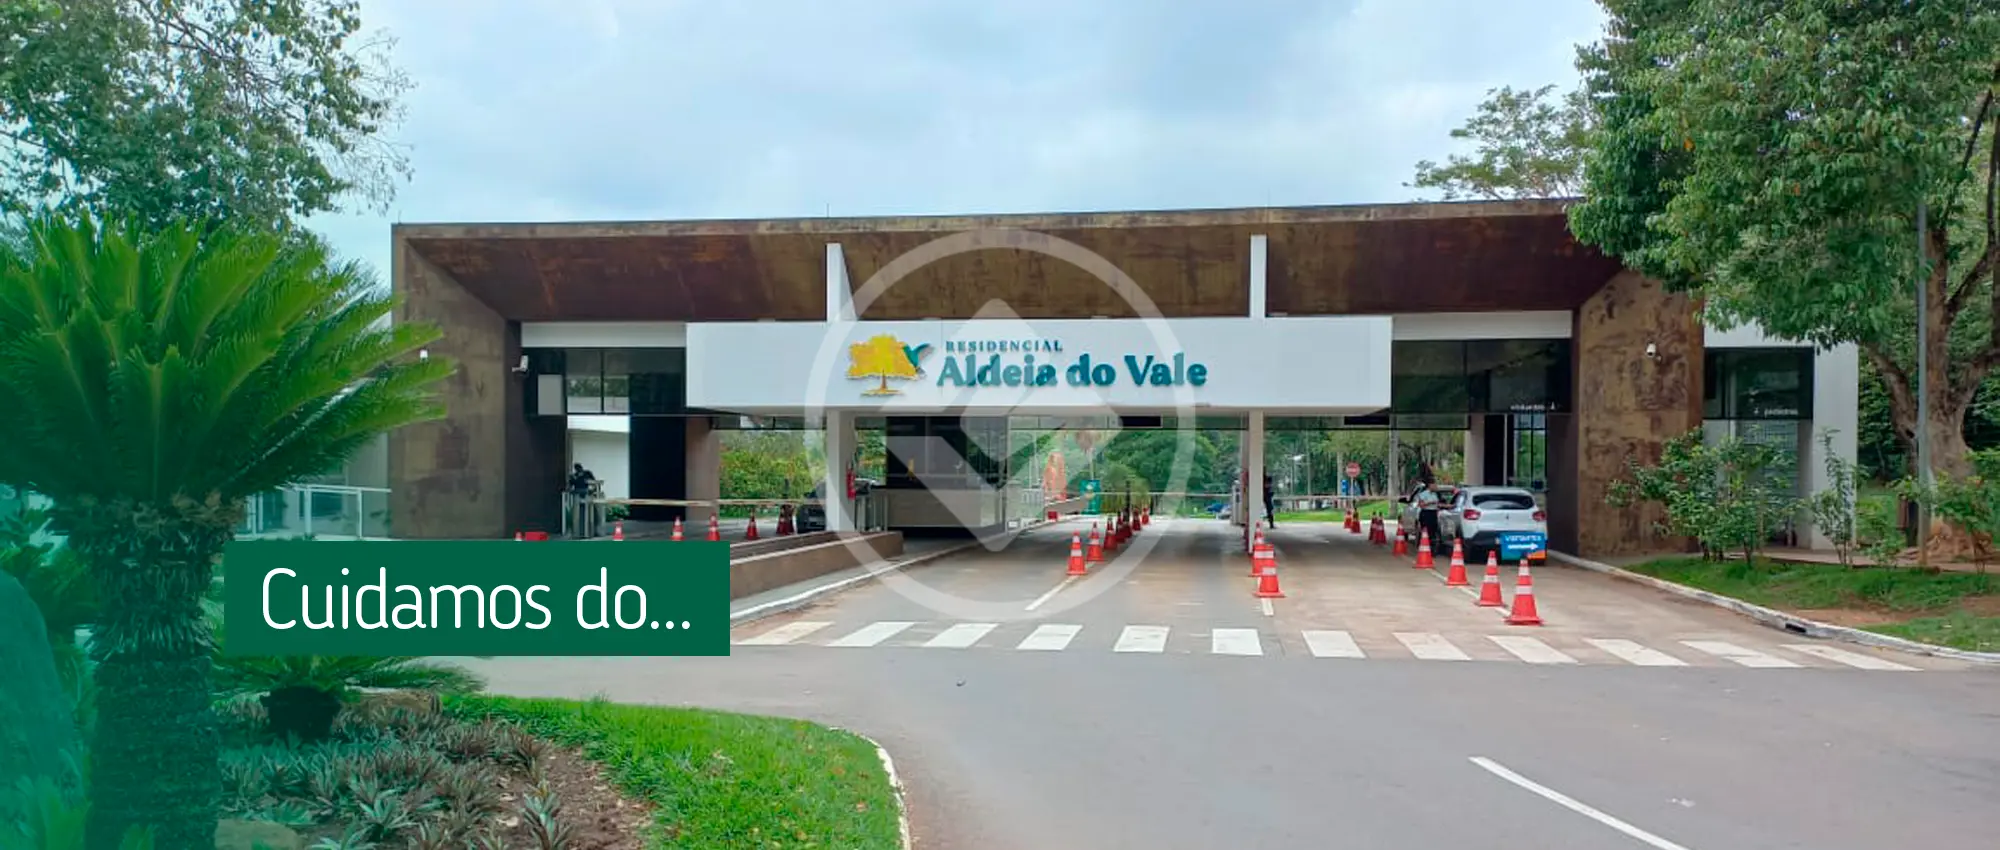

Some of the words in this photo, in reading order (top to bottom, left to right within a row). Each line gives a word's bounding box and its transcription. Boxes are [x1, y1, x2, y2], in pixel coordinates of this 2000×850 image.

[945, 340, 1063, 353] RESIDENCIAL
[936, 353, 1058, 387] Aldeia
[1066, 353, 1116, 386] do
[1123, 352, 1208, 387] Vale
